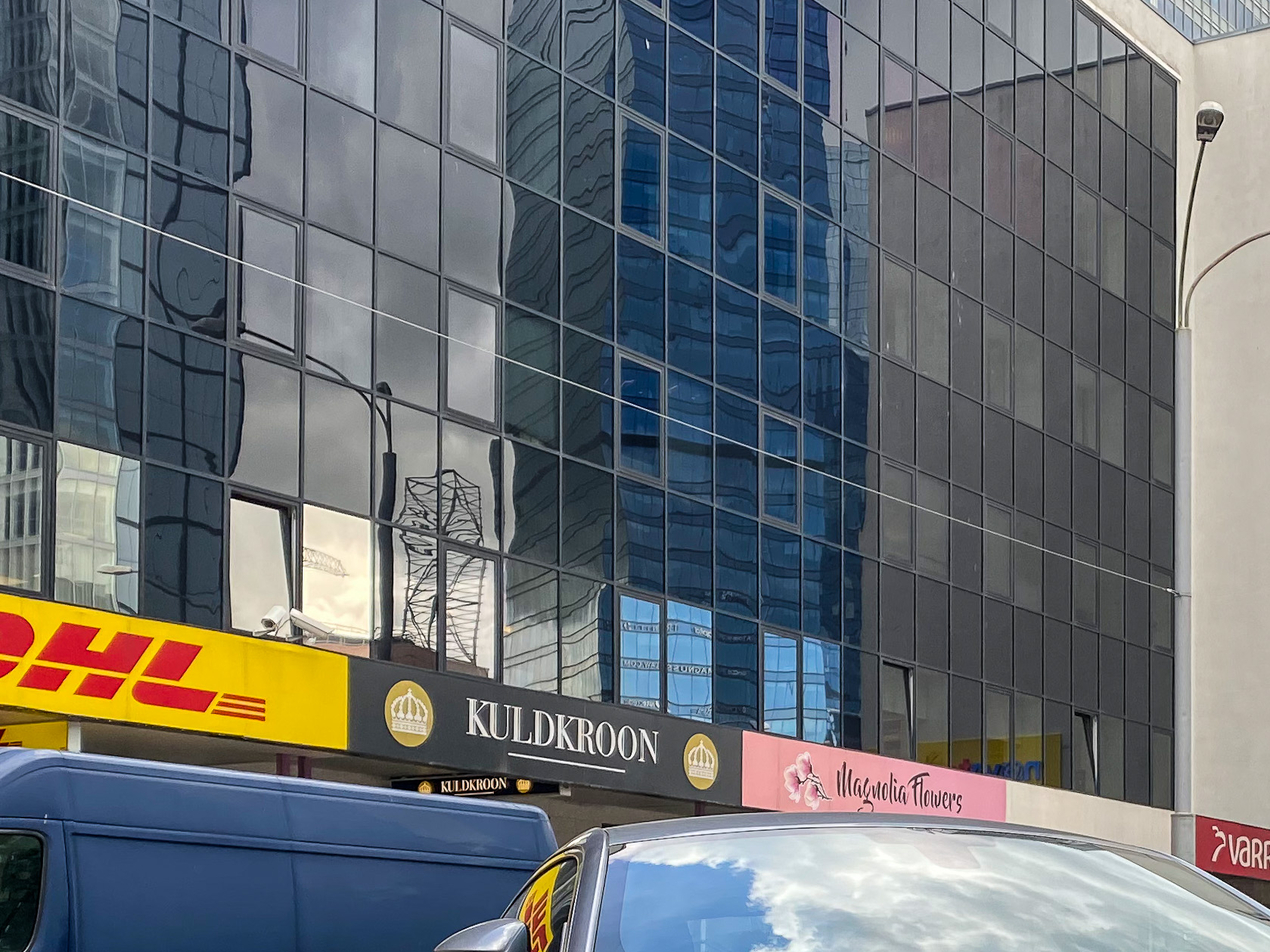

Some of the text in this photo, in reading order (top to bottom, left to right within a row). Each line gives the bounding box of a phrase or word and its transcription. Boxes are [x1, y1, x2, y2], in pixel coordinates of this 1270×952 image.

[465, 697, 659, 764] KULDKROON
[440, 776, 508, 793] KULDKROON
[836, 761, 963, 814] Magnolia Flowers
